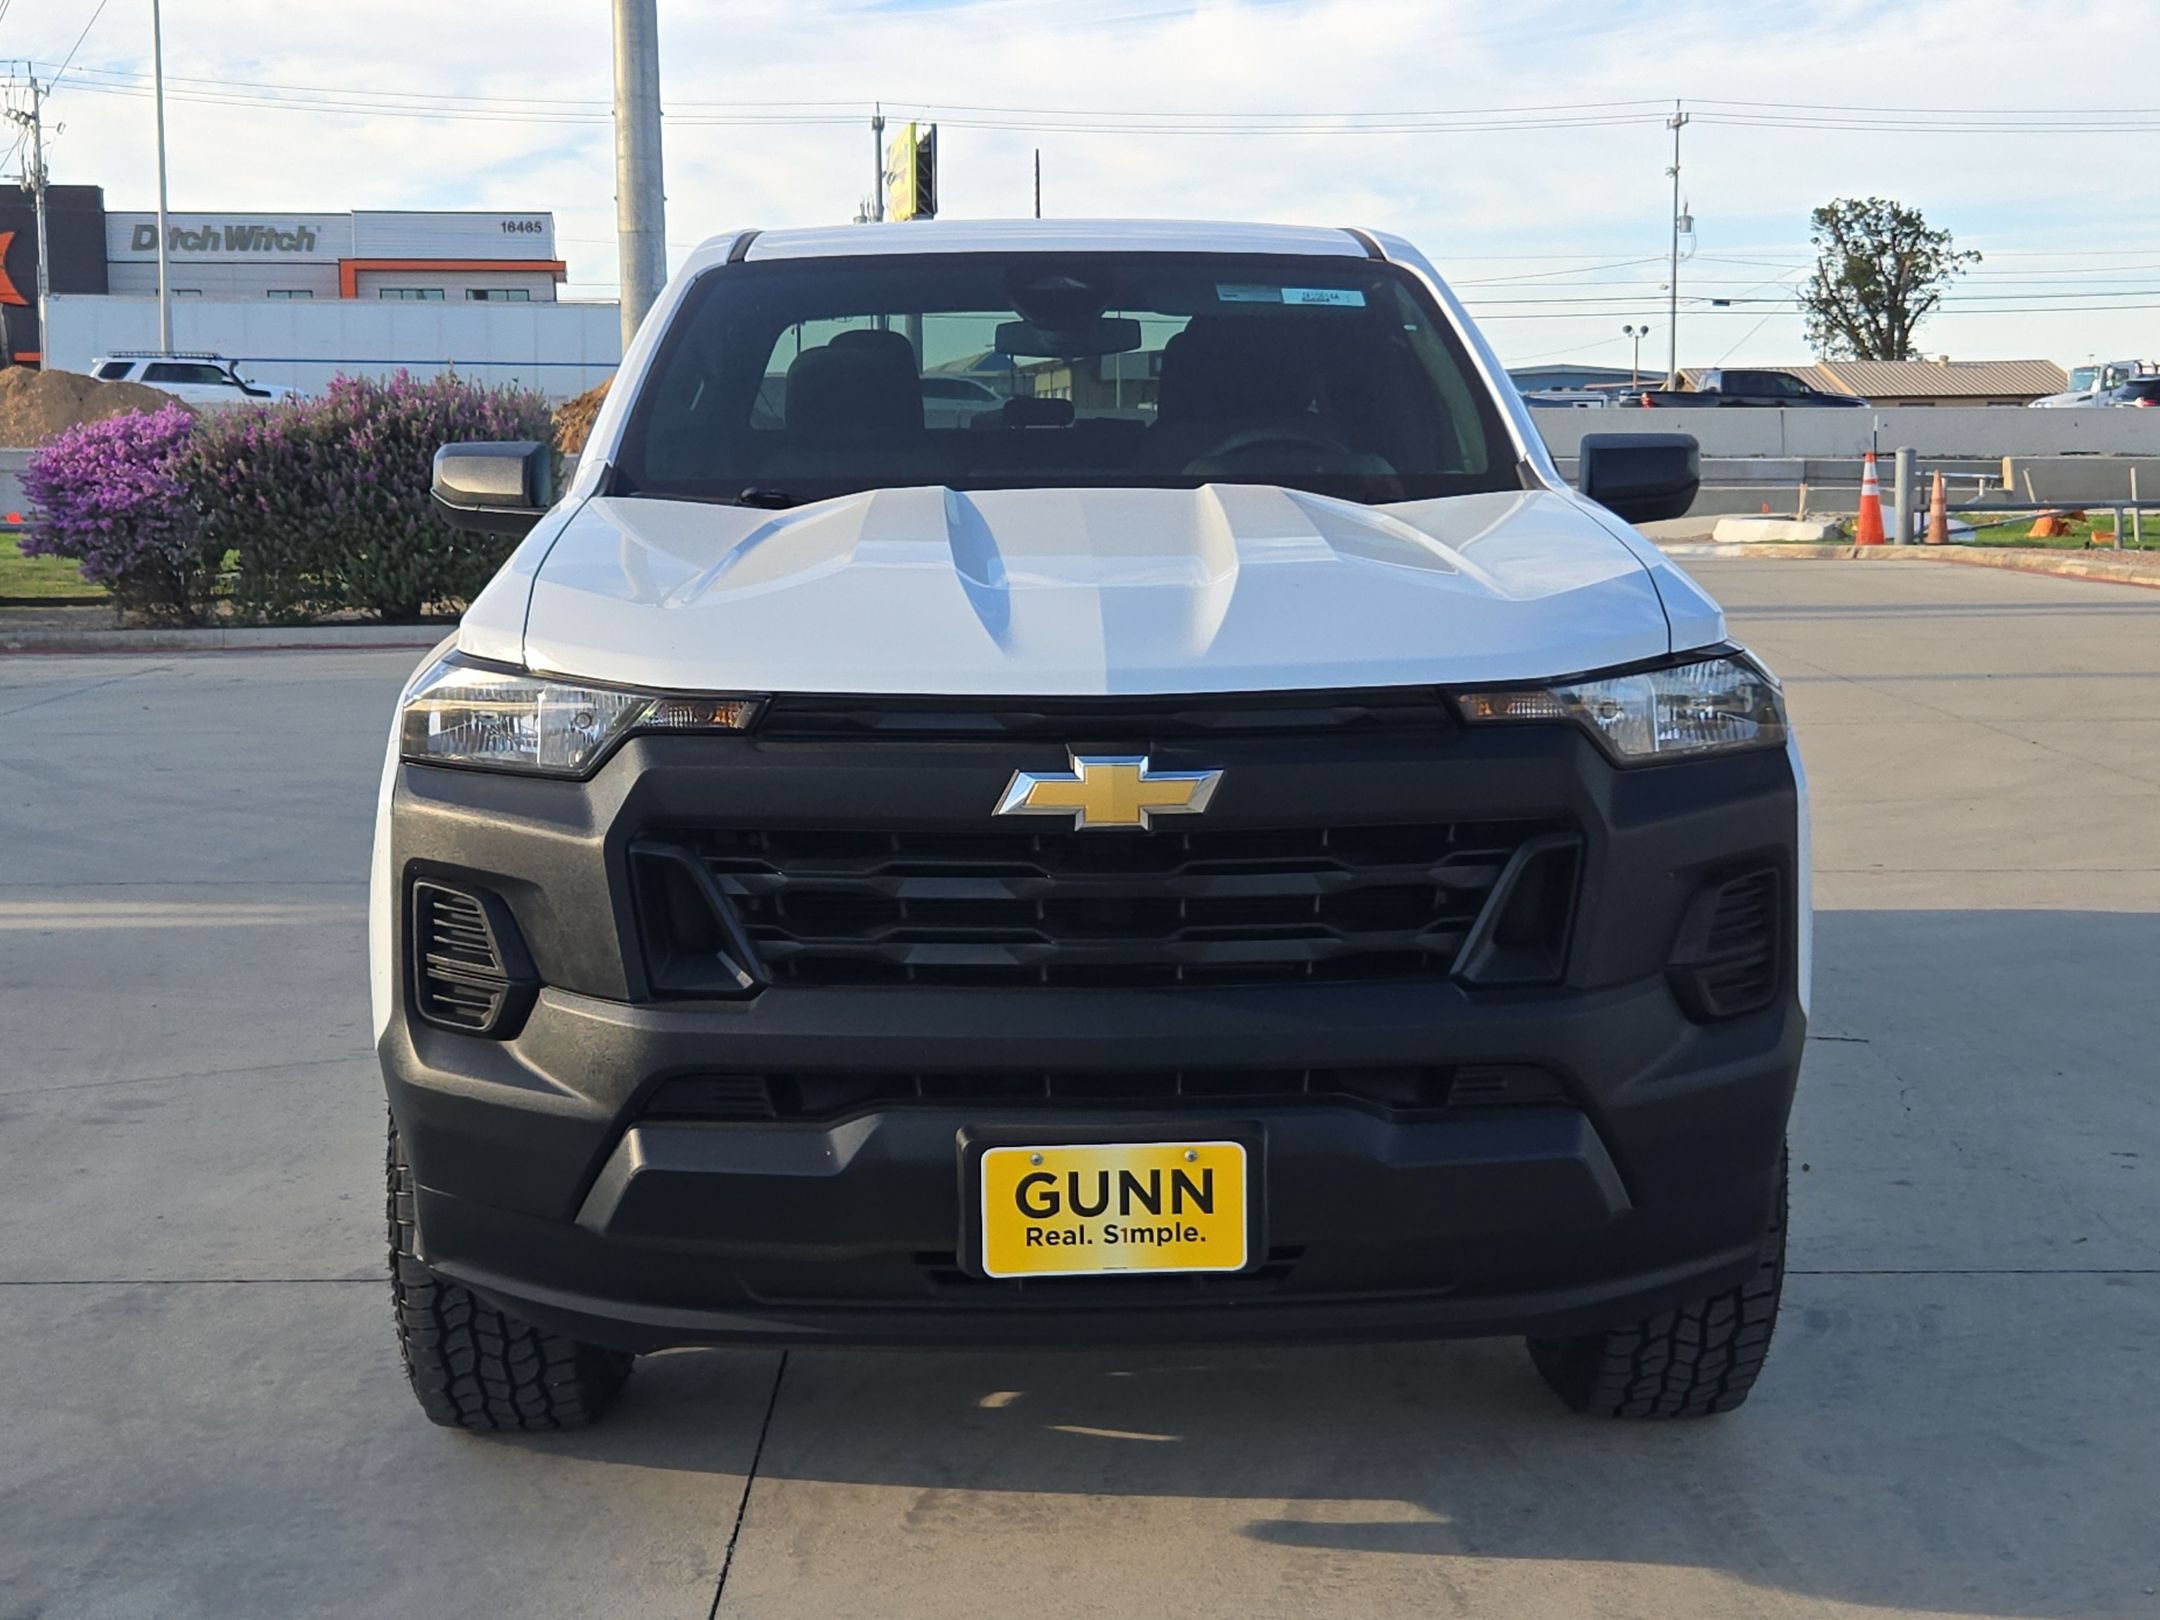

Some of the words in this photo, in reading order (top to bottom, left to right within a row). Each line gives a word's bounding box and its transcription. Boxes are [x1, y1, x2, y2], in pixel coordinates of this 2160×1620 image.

[131, 224, 221, 252] Dtch
[224, 225, 316, 252] Witch
[501, 220, 542, 234] 16465
[1015, 1168, 1214, 1219] GUNN
[1026, 1224, 1093, 1247] Real.
